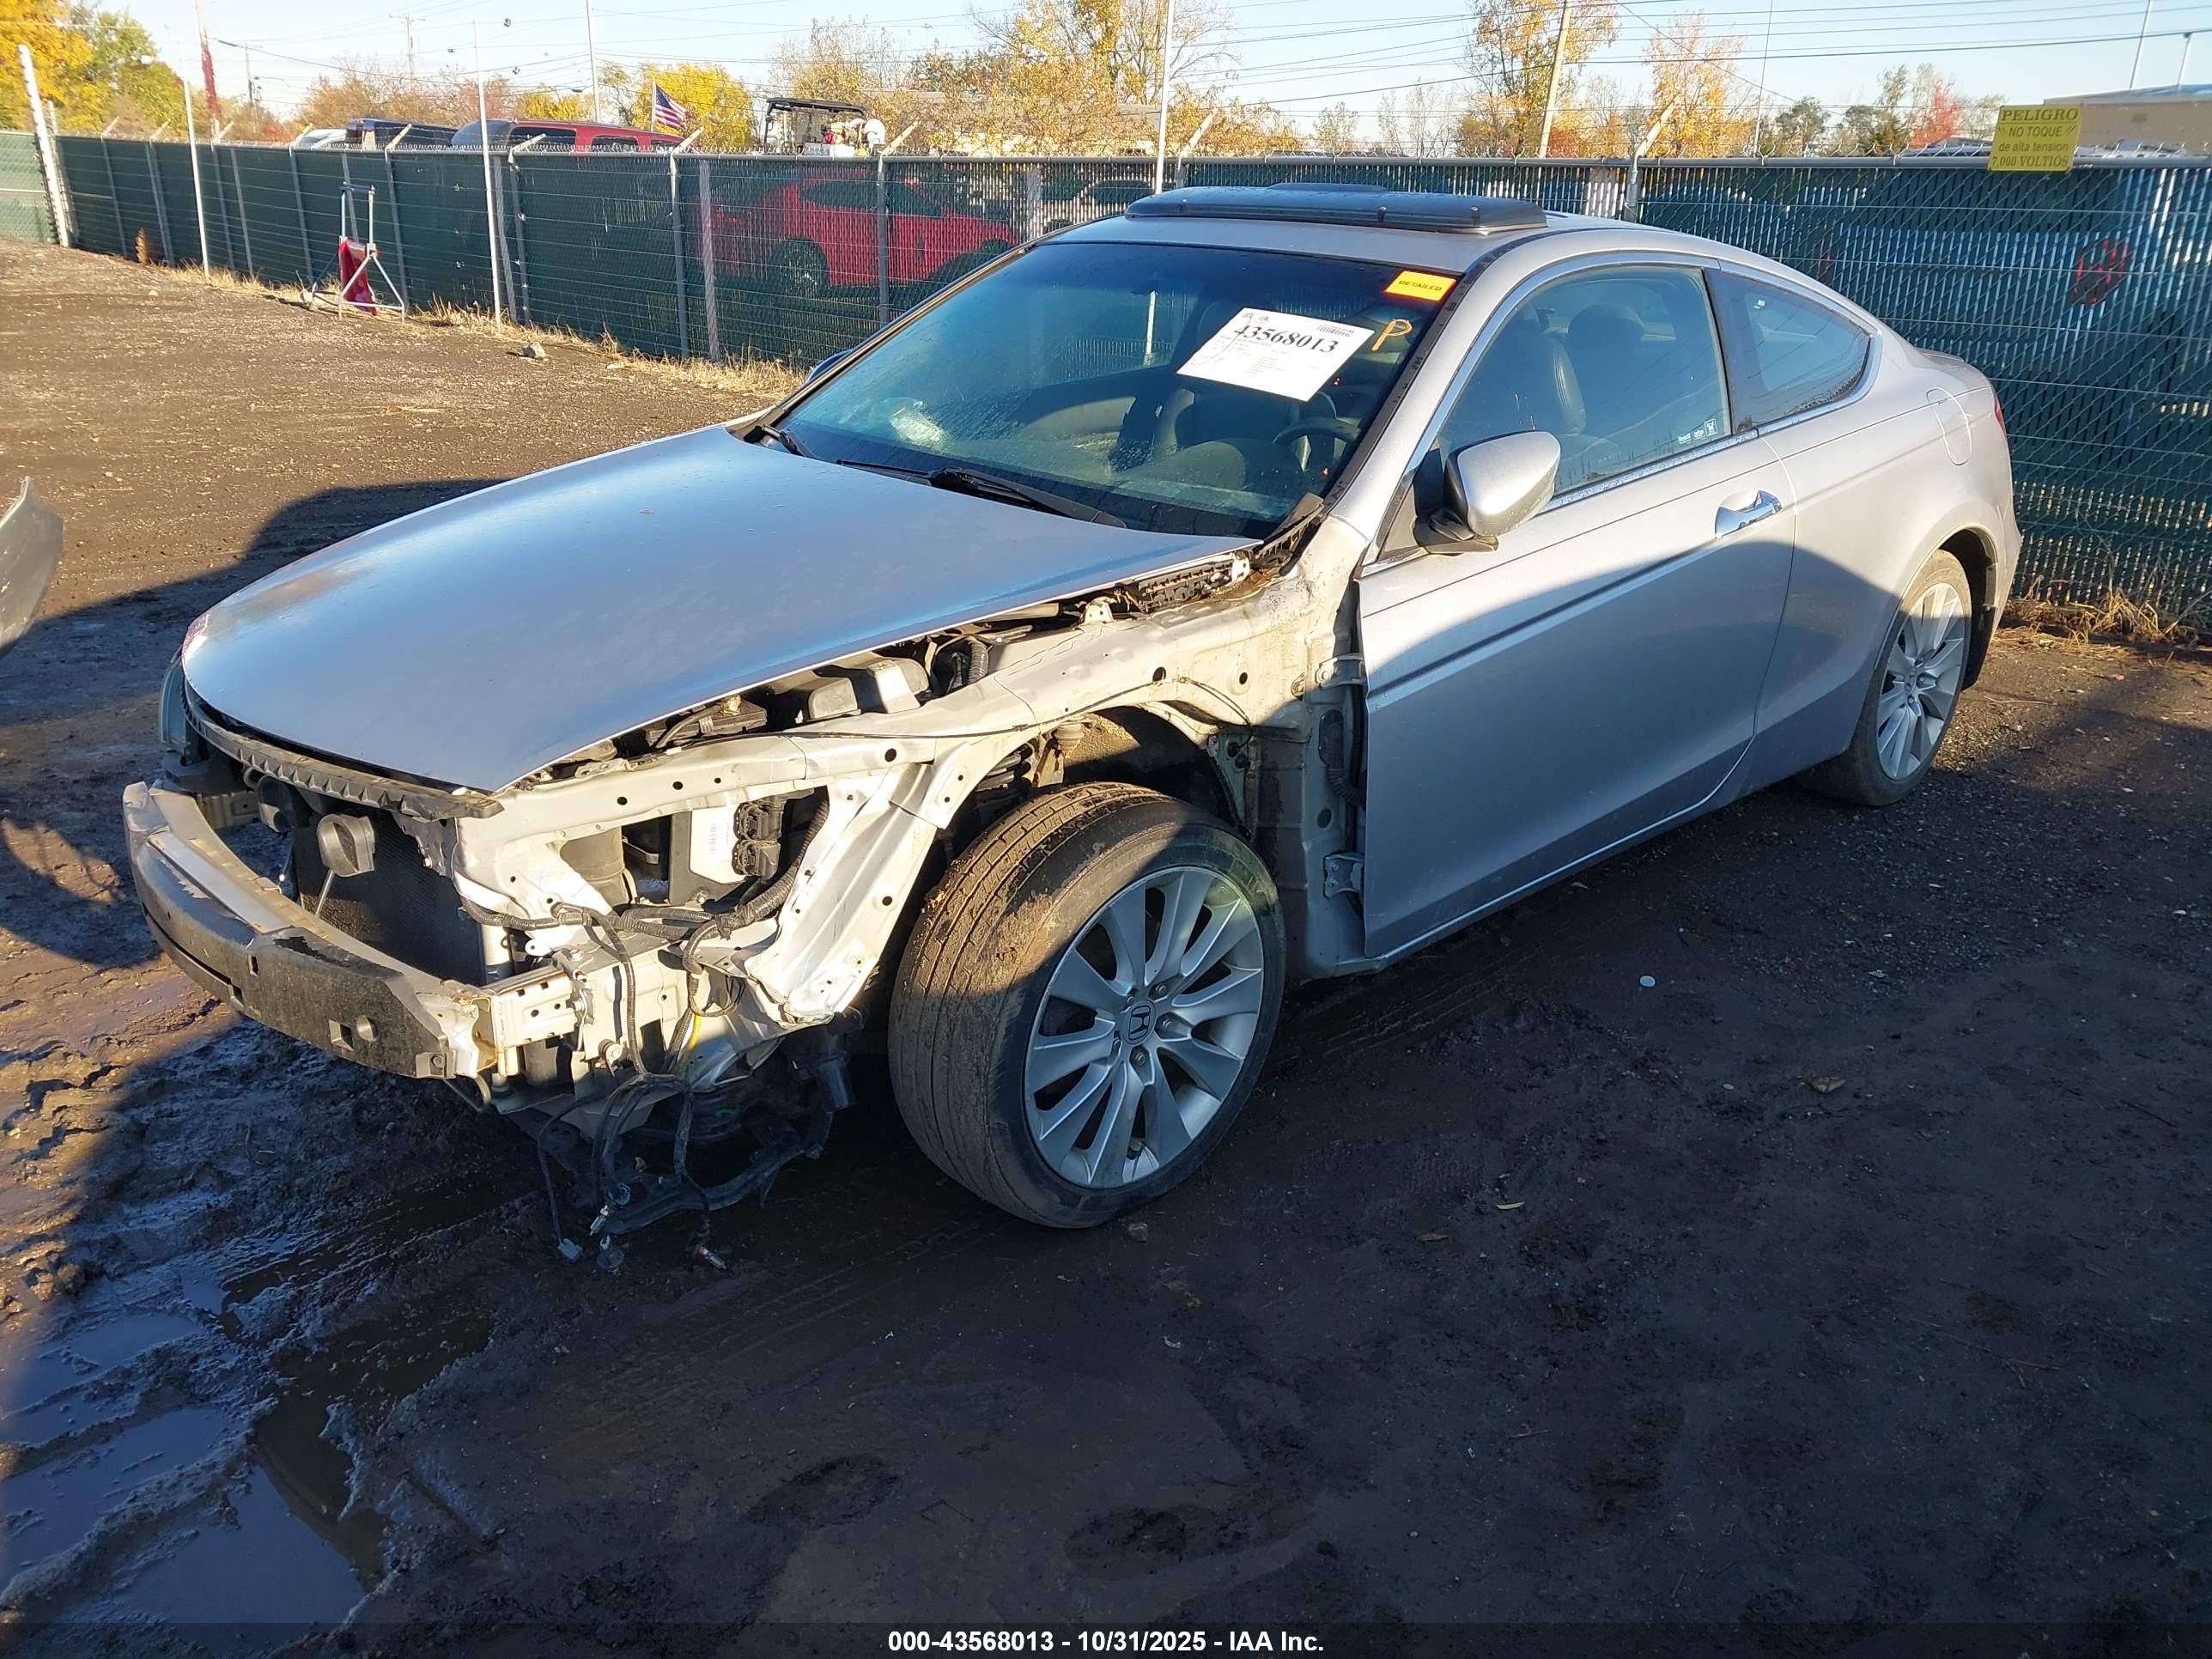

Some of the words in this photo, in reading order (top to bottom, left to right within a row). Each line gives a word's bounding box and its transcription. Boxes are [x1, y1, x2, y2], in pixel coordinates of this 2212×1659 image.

[2002, 108, 2078, 121] PELIGRO
[2009, 126, 2024, 137] NO
[2027, 126, 2062, 137] TOQUE
[1998, 141, 2010, 152] de
[2013, 142, 2030, 152] alta
[2033, 143, 2069, 152] tension
[2020, 155, 2069, 167] VOLTIOS
[1398, 280, 1443, 292] DETAILED
[1234, 325, 1340, 353] 43568013
[1371, 319, 1413, 351] P
